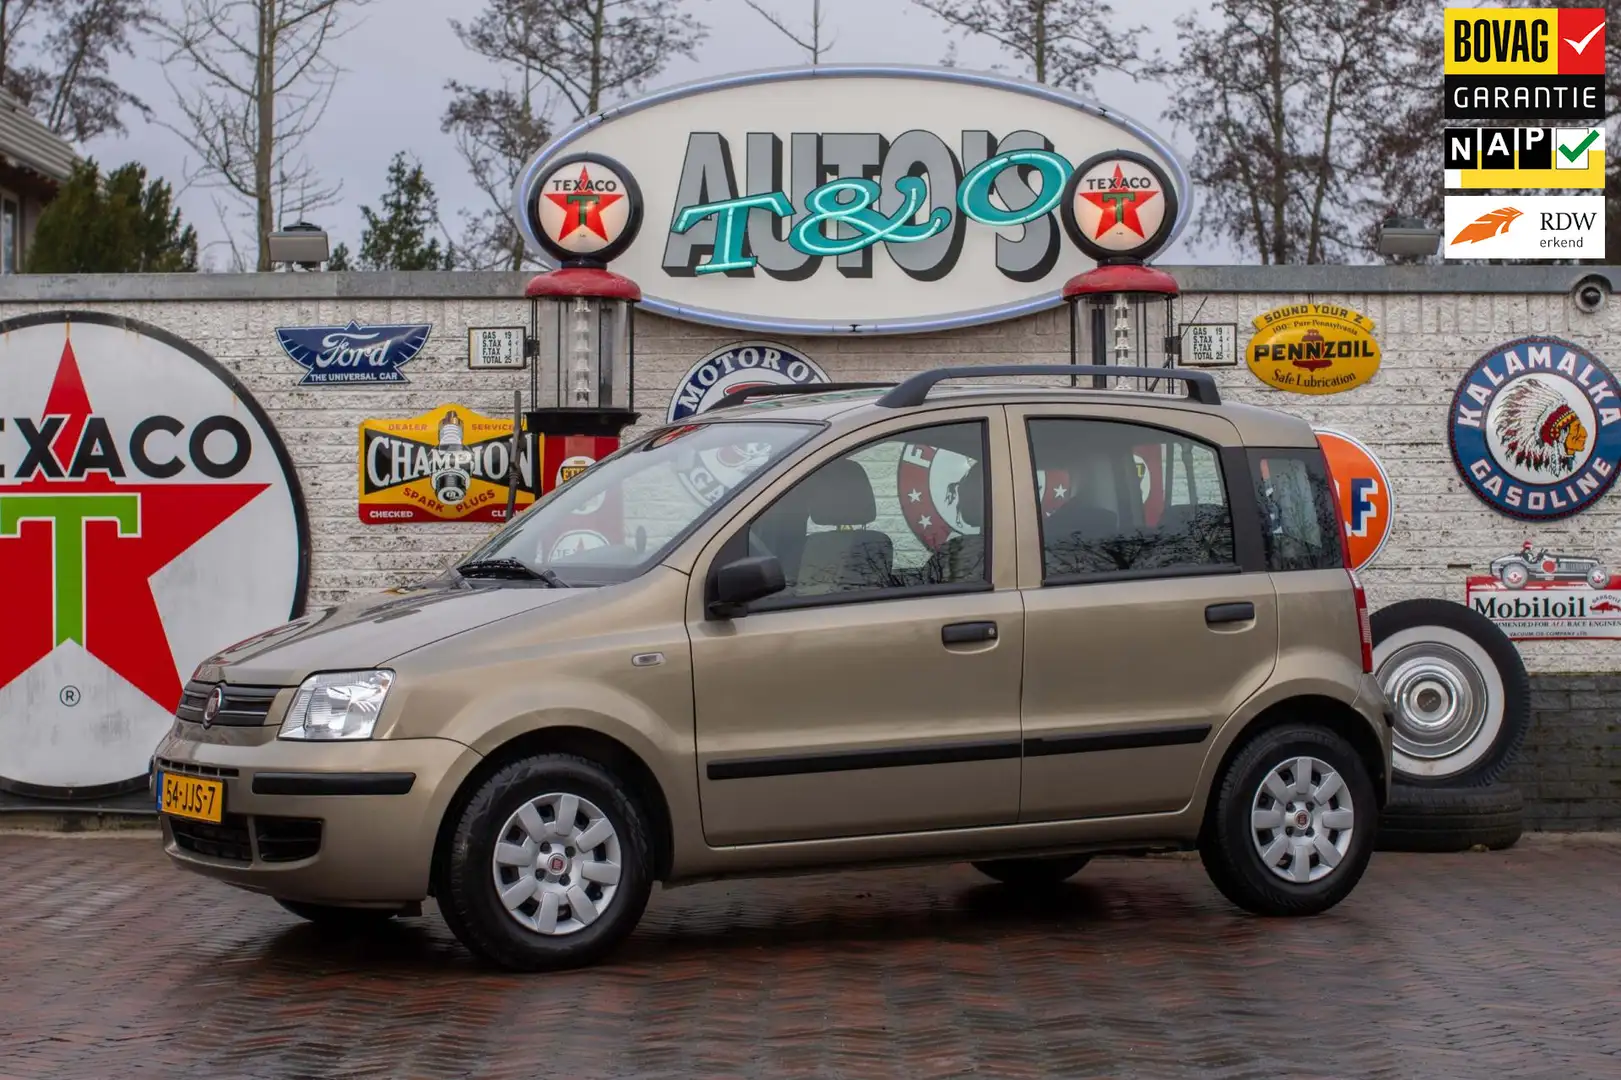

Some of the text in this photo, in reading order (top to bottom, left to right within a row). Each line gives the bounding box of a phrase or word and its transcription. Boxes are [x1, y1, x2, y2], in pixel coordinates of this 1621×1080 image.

[553, 180, 617, 192] TEXACO
[1086, 177, 1151, 190] TEXACO
[661, 128, 1061, 282] AUTO'S
[1264, 304, 1364, 324] SOUND YOUR Z
[482, 331, 512, 340] GAS 19
[1192, 327, 1223, 336] GAS 19
[1312, 319, 1358, 336] Pennsylvania
[482, 340, 502, 348] S.TAX
[1193, 336, 1213, 344] S.TAX
[1193, 344, 1223, 352] F.TAX 1
[315, 332, 392, 368] Ford
[482, 348, 512, 356] F.TAX 1
[1194, 351, 1224, 360] TOTAL 25
[1254, 340, 1375, 362] PENNZOIL
[483, 356, 512, 364] TOTAL 25
[311, 372, 398, 382] THE UNIVERSAL CAR
[678, 348, 782, 413] MOTOR
[1272, 368, 1357, 388] Safe Lubrication
[1457, 346, 1621, 428] KALAMALKA
[388, 423, 428, 431] DEALER
[367, 432, 533, 488] CHAMPION
[1470, 457, 1612, 511] GASOLINE
[402, 487, 444, 513] SPARK
[455, 489, 496, 513] PLUGS
[369, 510, 414, 518] CHECKED
[1474, 596, 1586, 618] Mobiloil
[166, 779, 216, 815] 54-JJS-7
